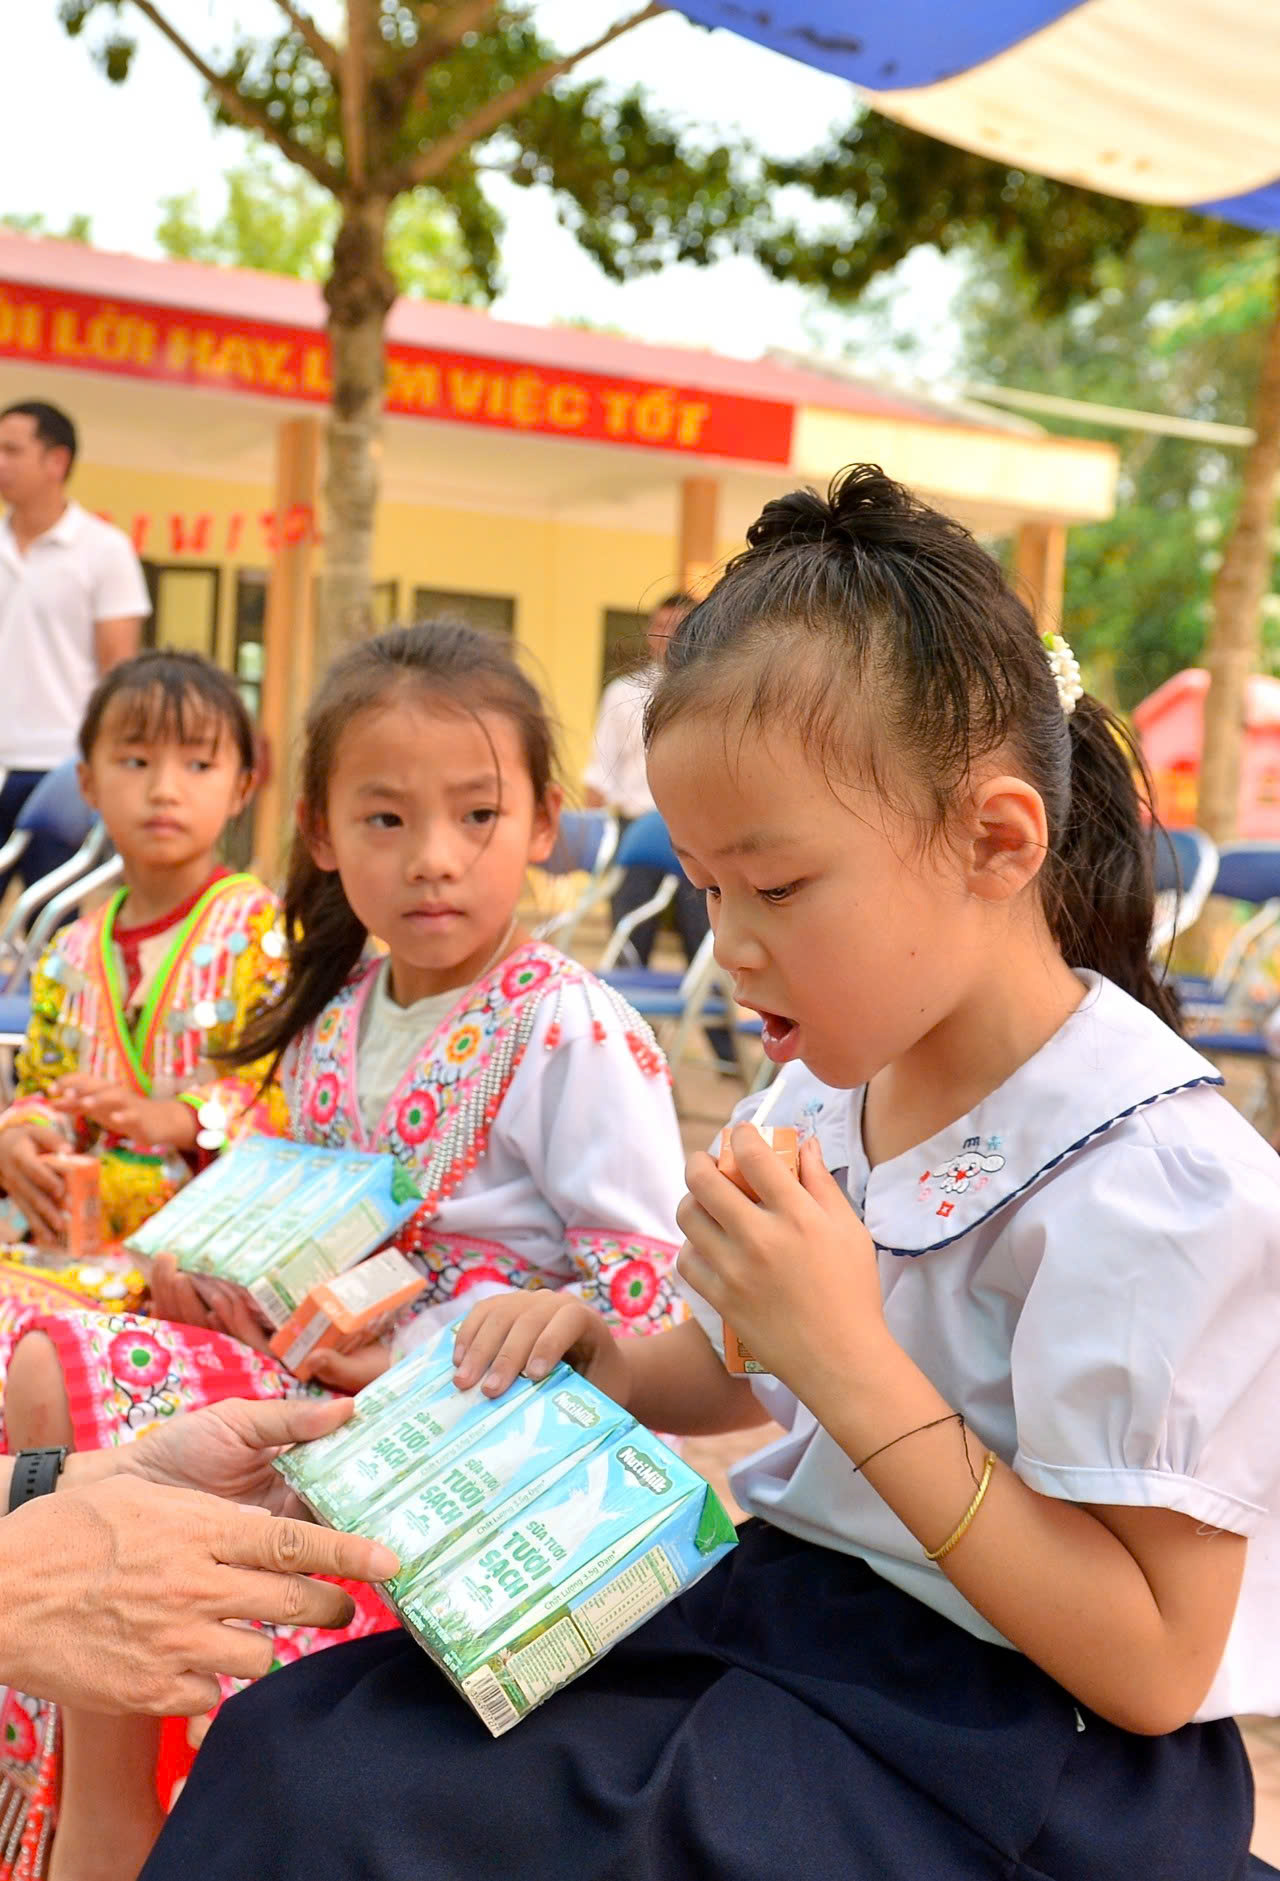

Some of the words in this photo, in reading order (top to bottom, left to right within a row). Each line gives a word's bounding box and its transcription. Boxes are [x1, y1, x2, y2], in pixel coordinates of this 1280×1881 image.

[303, 348, 439, 408] LM
[450, 366, 589, 431] VIỆC
[600, 385, 710, 446] TỐT
[618, 1446, 666, 1493] NutiMilk
[419, 1485, 464, 1525] SẠCH
[478, 1549, 529, 1598] SẠCH
